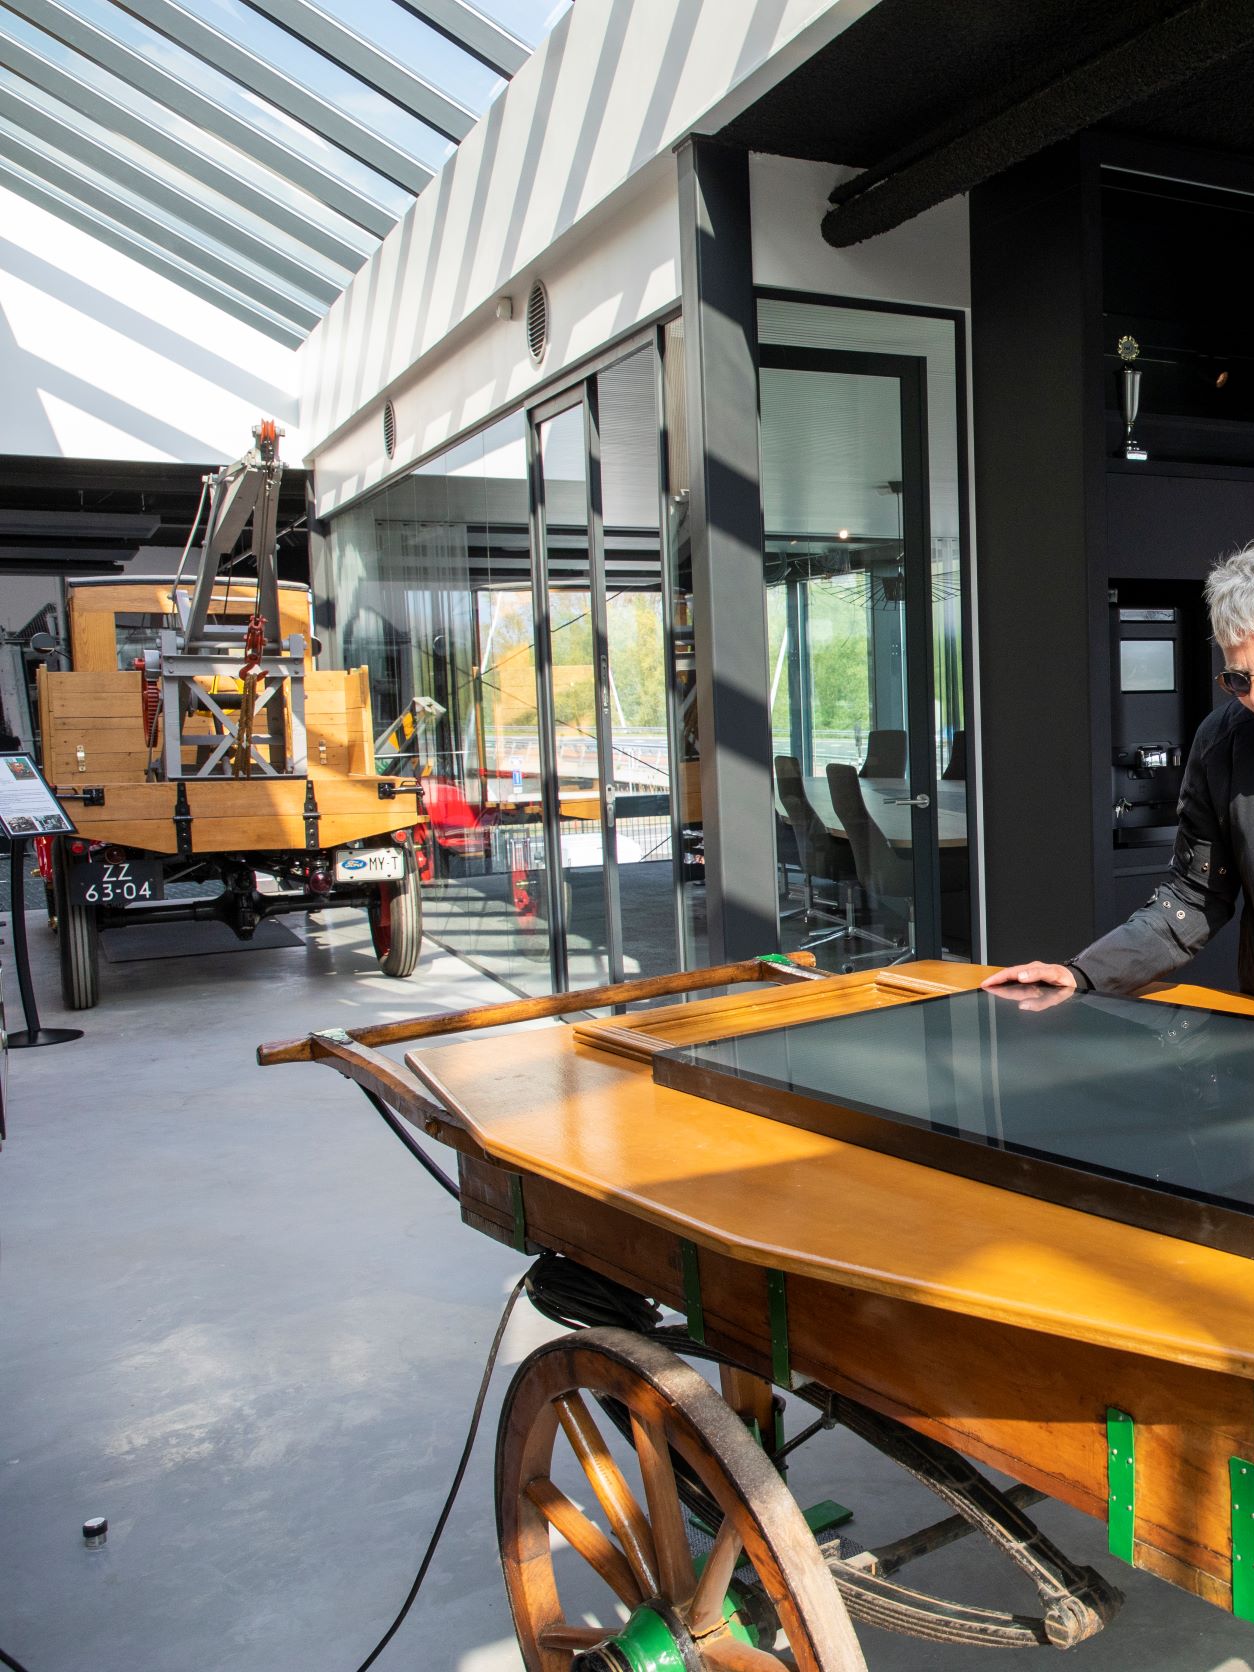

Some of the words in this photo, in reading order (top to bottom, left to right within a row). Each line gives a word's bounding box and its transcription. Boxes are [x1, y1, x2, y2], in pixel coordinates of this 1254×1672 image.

[102, 863, 132, 881] ZZ
[369, 856, 398, 871] MY-T
[85, 881, 151, 901] 63-04
